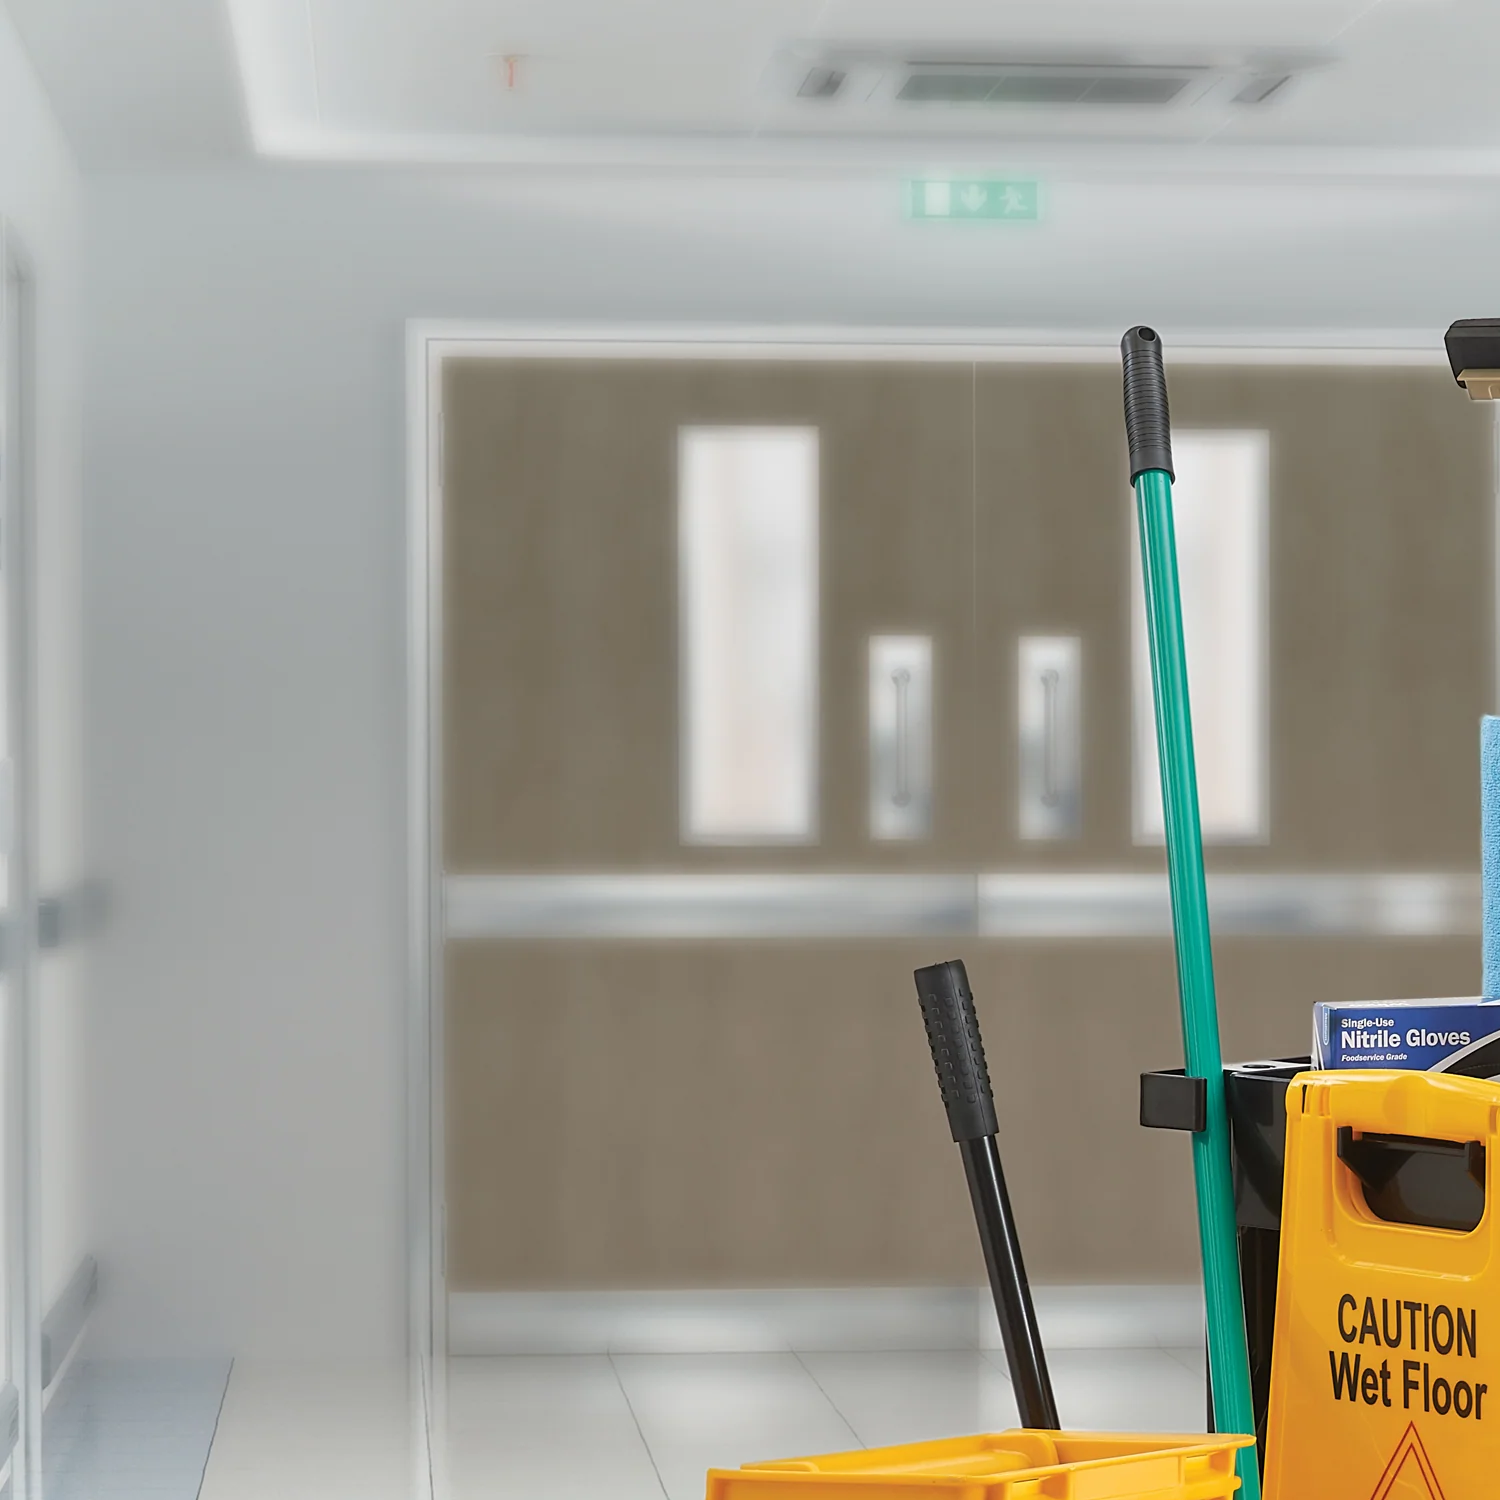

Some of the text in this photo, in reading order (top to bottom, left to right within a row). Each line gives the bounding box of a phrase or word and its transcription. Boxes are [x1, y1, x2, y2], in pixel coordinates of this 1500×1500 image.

[1341, 1017, 1395, 1029] Single-Use
[1341, 1028, 1471, 1049] Nitrile Gloves
[1341, 1052, 1408, 1062] Foodservice Grade
[1337, 1293, 1477, 1358] CAUTION
[1328, 1350, 1488, 1420] Wet Floor
